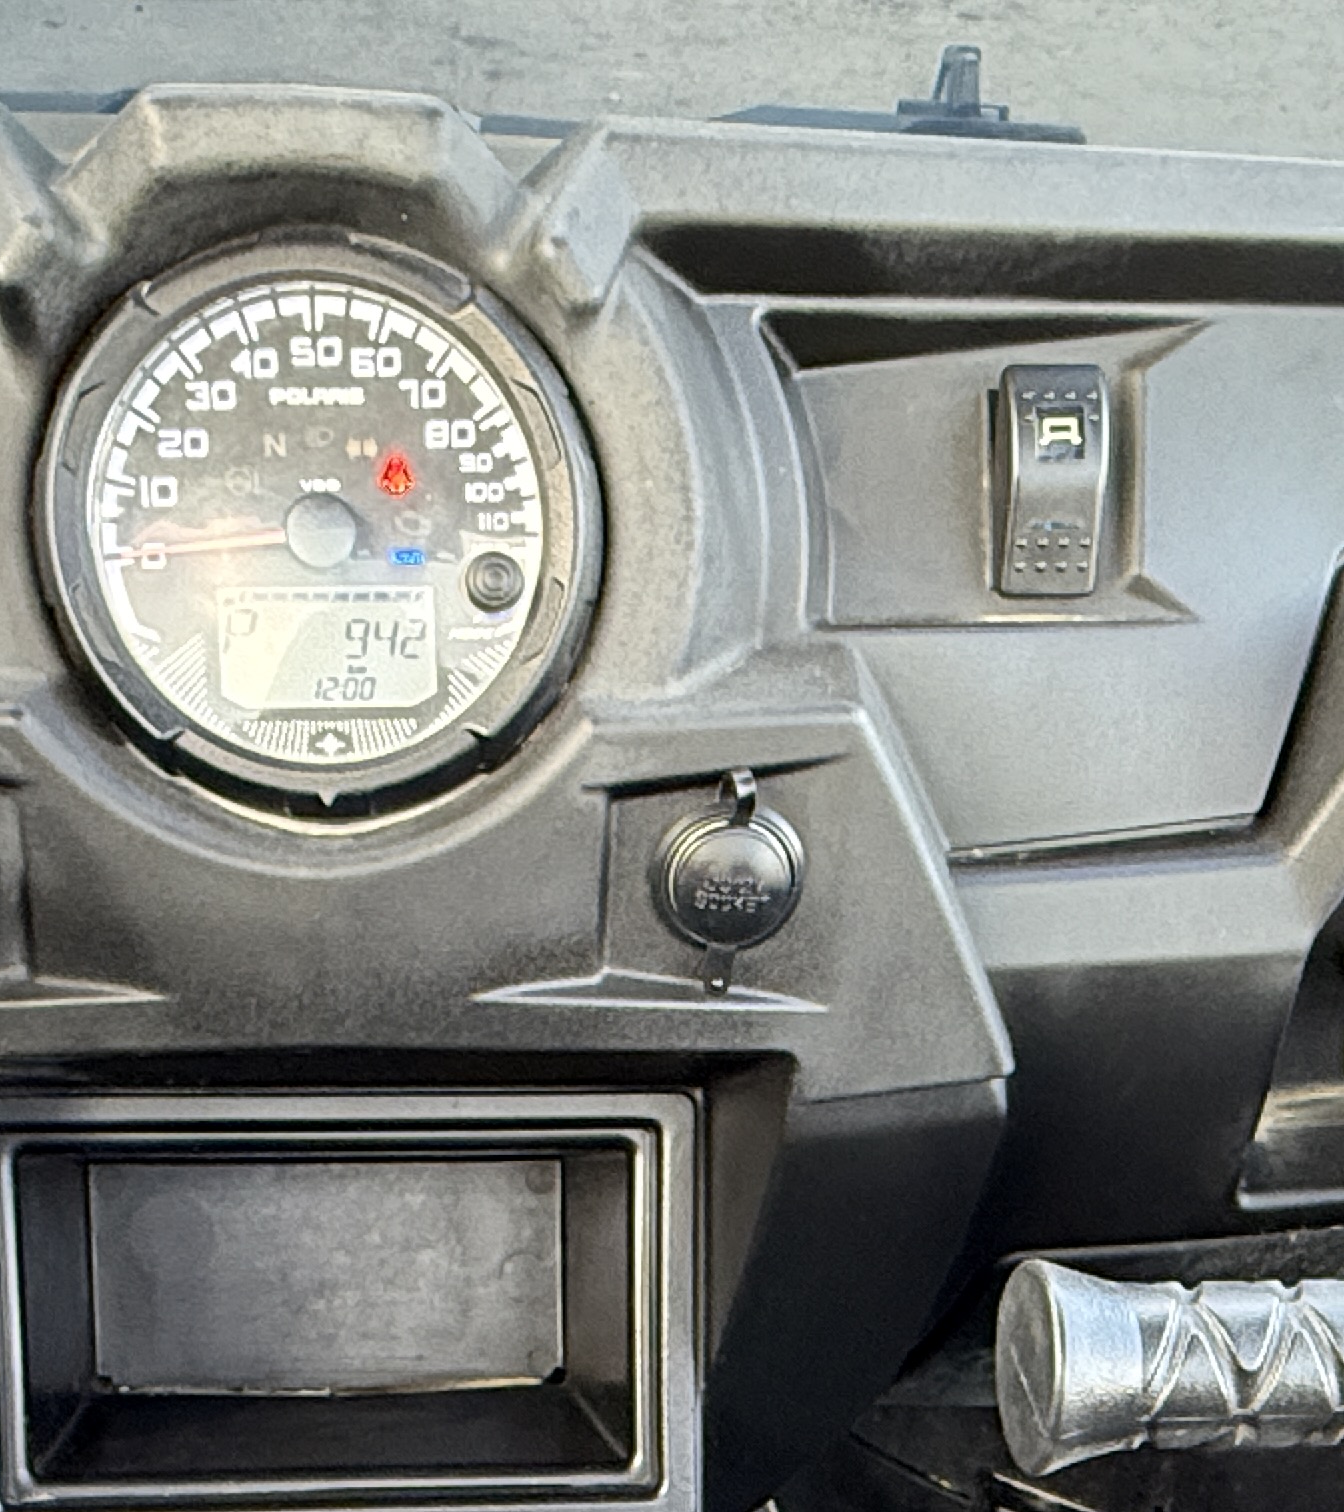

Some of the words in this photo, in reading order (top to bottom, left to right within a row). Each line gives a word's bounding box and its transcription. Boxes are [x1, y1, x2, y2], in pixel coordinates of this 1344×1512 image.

[230, 347, 279, 379] 40
[290, 335, 342, 367] 50
[350, 347, 401, 377] 60
[184, 380, 236, 411] 30
[268, 386, 365, 406] POLARIS
[398, 379, 446, 409] 70
[158, 428, 209, 458] 20
[263, 431, 287, 457] N
[425, 419, 476, 449] 80
[459, 453, 493, 473] 90
[139, 475, 178, 508] 10
[465, 482, 504, 503] 100
[477, 512, 509, 531] 110
[141, 542, 166, 569] 0
[345, 618, 427, 660] 942
